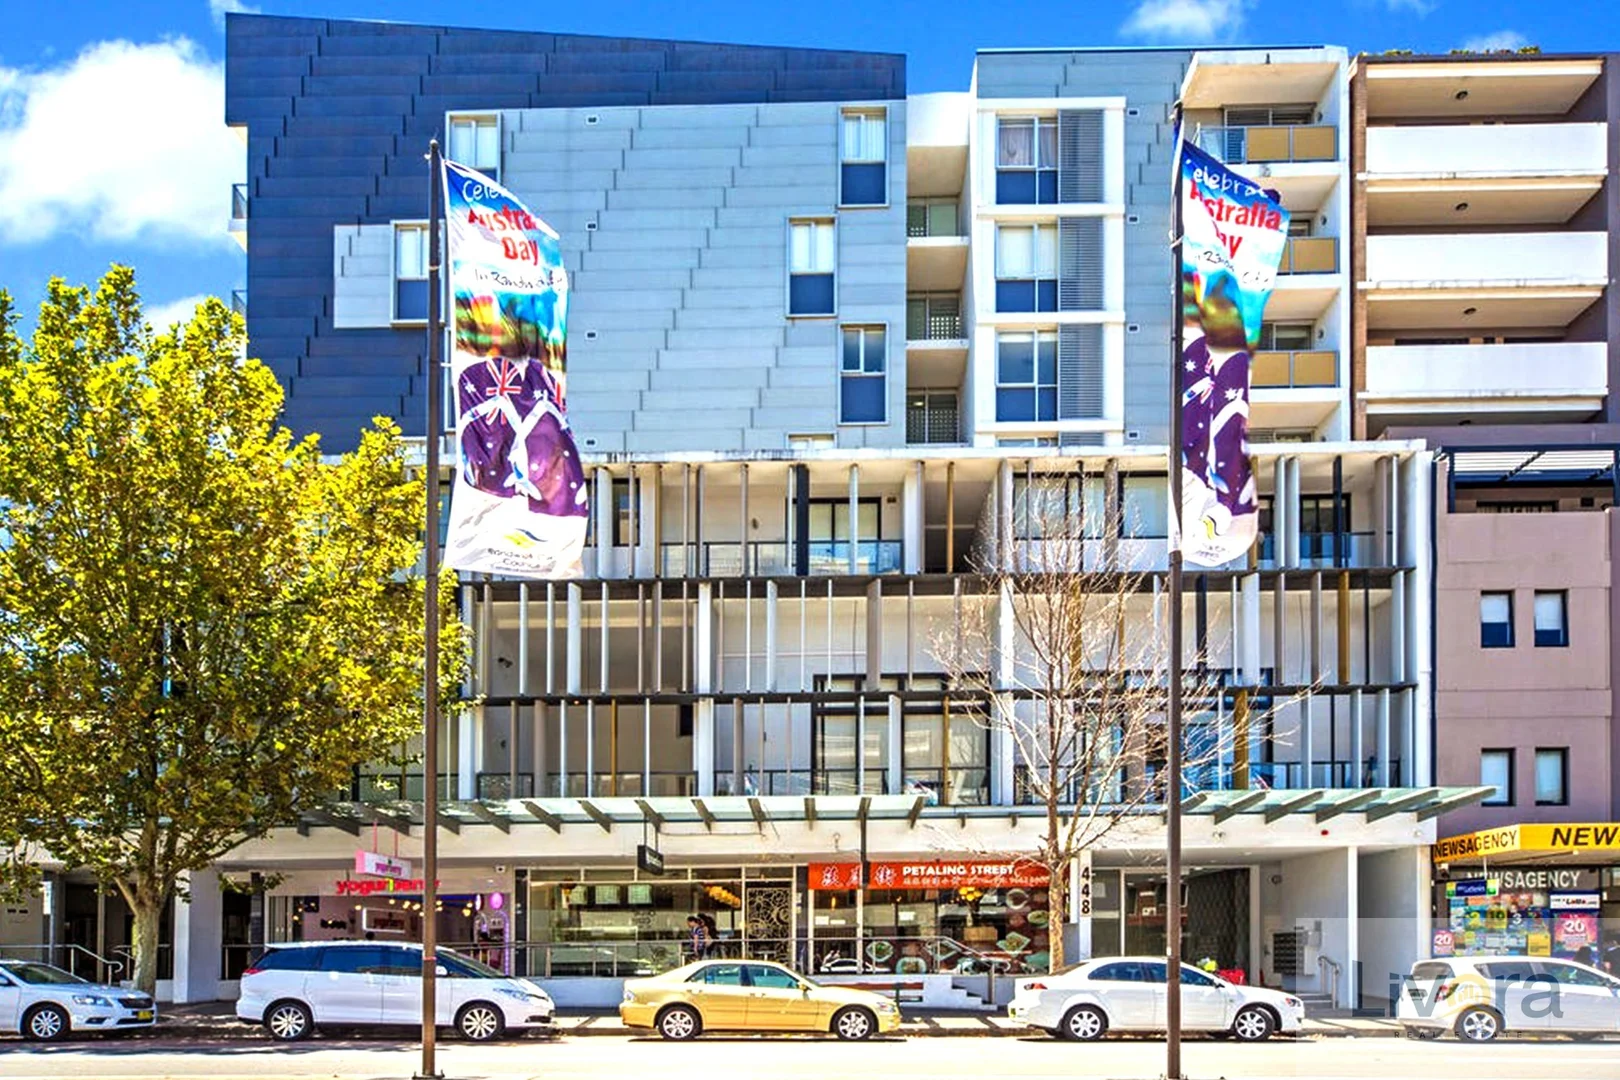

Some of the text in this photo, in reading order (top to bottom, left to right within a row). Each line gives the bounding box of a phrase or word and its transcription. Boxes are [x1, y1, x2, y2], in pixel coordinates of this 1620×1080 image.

[1190, 178, 1282, 231] Astralia
[501, 236, 539, 266] Day
[1433, 829, 1518, 859] NEWSAGENCY
[1551, 827, 1620, 846] NEW
[902, 865, 967, 876] PETALING
[1081, 866, 1090, 914] 448
